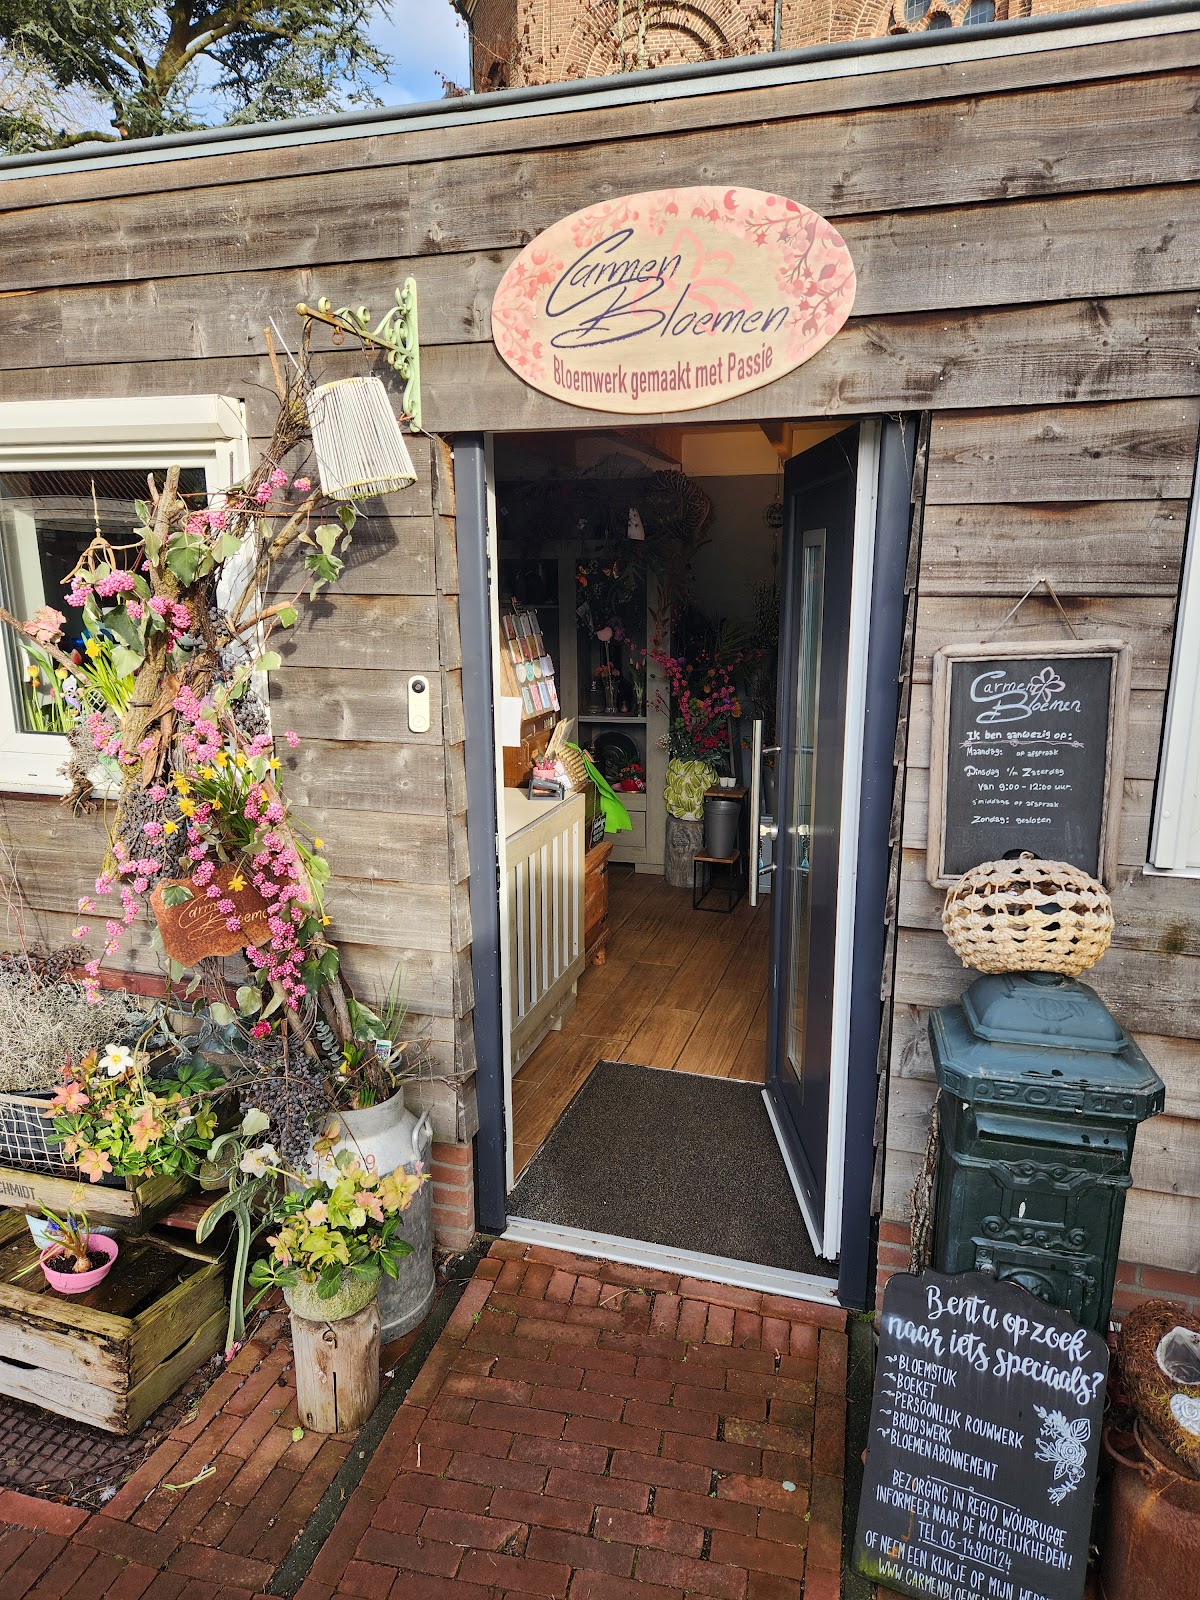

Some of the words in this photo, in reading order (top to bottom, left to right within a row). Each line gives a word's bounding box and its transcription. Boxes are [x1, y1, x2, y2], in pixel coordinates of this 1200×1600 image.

[546, 229, 682, 317] Carmen
[551, 277, 790, 349] Bloemen
[553, 354, 628, 394] Bloemwerk
[631, 361, 691, 401] gemaakt
[695, 357, 723, 388] met
[727, 342, 773, 383] Passie
[970, 671, 1035, 702] Carmen
[976, 684, 1081, 723] Bloemen
[966, 730, 980, 740] Ik
[984, 730, 1002, 740] ben
[1006, 730, 1051, 740] aanwezig
[1053, 732, 1073, 741] op:
[966, 746, 1003, 757] Maandag:
[1027, 749, 1059, 757] afspraak
[963, 765, 1000, 777] Dinsdag
[1022, 767, 1065, 777] Zaterdag
[998, 783, 1020, 791] 9:00
[1029, 783, 1052, 791] 12:00
[971, 815, 1010, 824] Zondag:
[1015, 816, 1052, 824] gesloten
[179, 893, 218, 928] Carm
[992, 1081, 1117, 1111] POST
[1030, 1321, 1092, 1362] zoek
[888, 1316, 946, 1356] naar
[949, 1329, 990, 1371] iets
[992, 1347, 1105, 1405] speciaals?
[898, 1353, 958, 1387] BLOEMSTUK
[896, 1373, 937, 1400] BOEKET
[892, 1411, 952, 1445] BRUIDSWERK
[894, 1390, 962, 1429] PERSOONLIJK
[964, 1415, 1025, 1449] ROUWWERK
[876, 1484, 930, 1519] INFORMEER
[932, 1505, 960, 1529] NAAR
[962, 1516, 975, 1535] DE
[978, 1520, 1073, 1571] MOGELIJKHEDEN!
[892, 1469, 949, 1504] BEZORGING
[952, 1489, 965, 1510] IN
[967, 1496, 998, 1522] REGIO
[1002, 1509, 1067, 1549] WOUBRUGGE
[918, 1520, 939, 1544] TEL.
[940, 1530, 1012, 1569] 06-14901124
[865, 1530, 879, 1549] OF
[880, 1535, 906, 1561] NEEM
[907, 1542, 927, 1569] EEN
[931, 1553, 967, 1583] KIJKJE
[970, 1570, 985, 1590] OP
[988, 1576, 1014, 1600] MIJN
